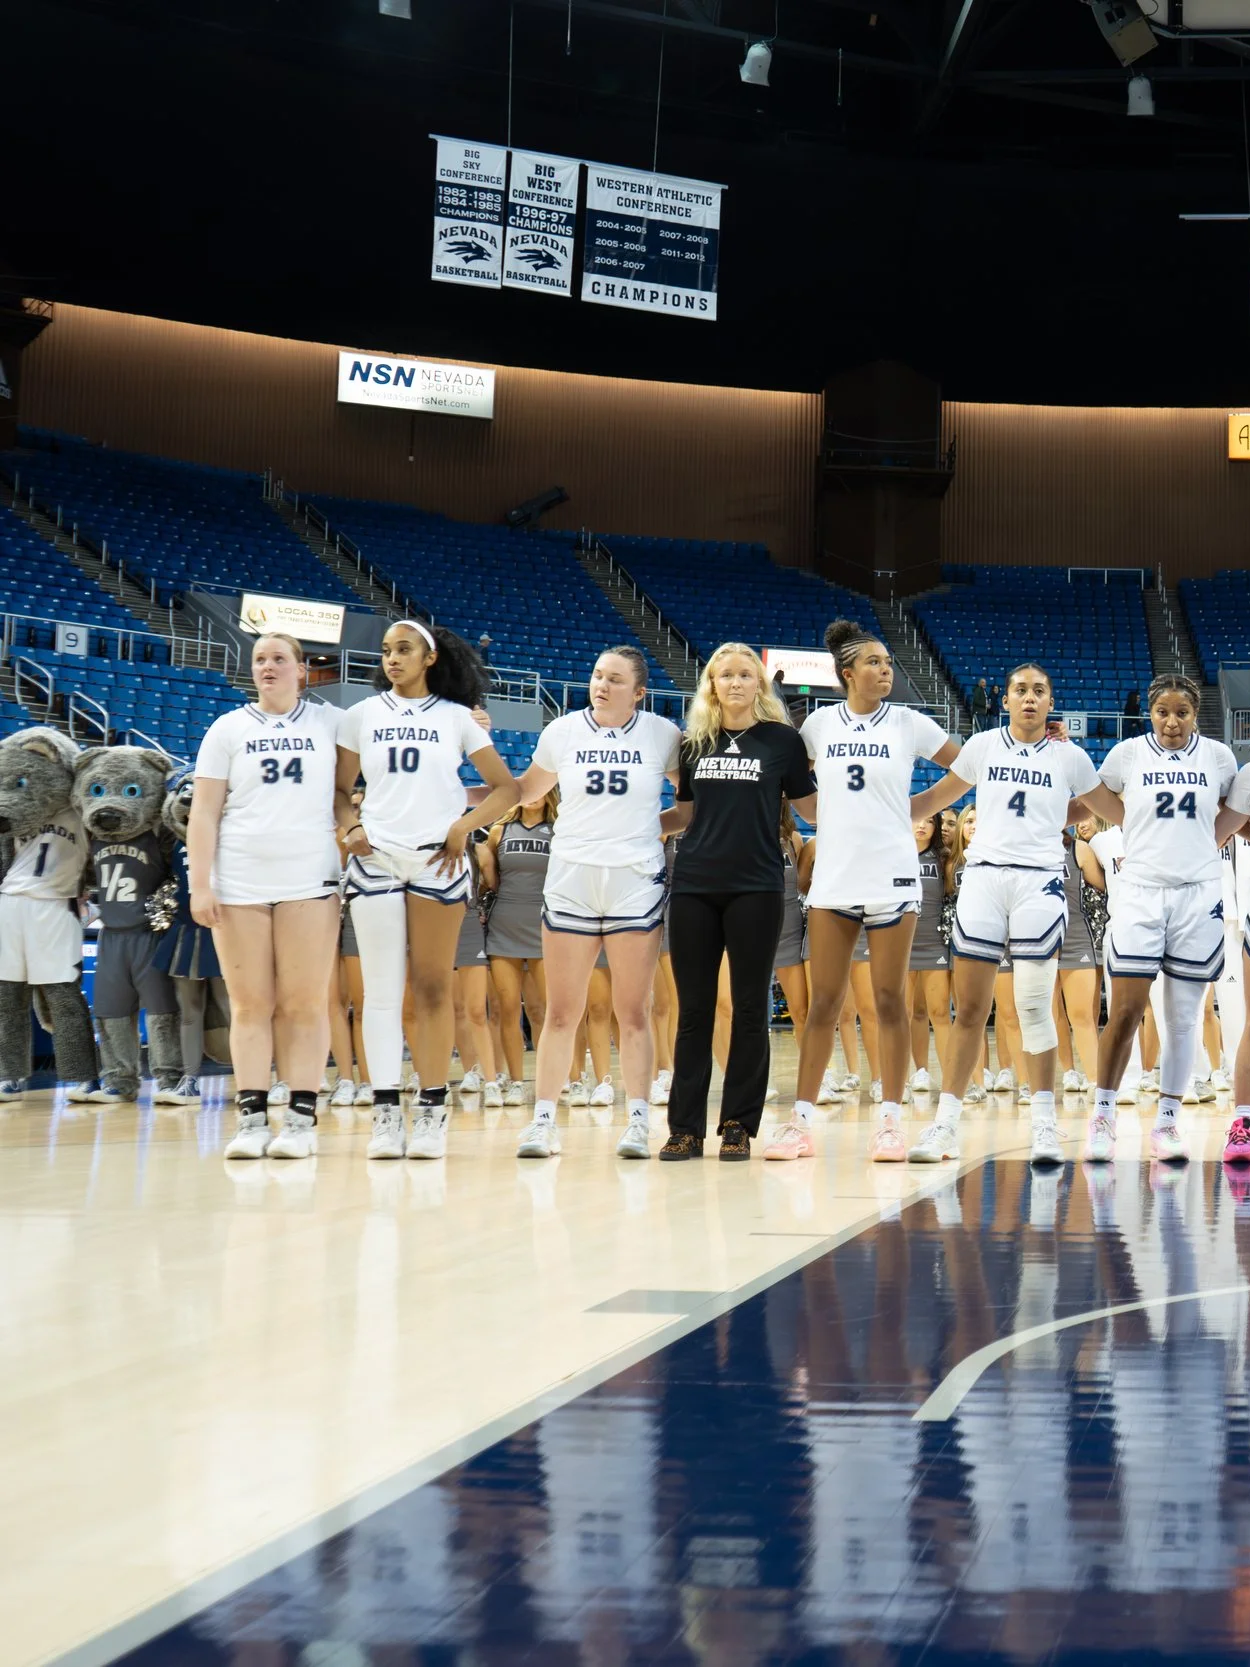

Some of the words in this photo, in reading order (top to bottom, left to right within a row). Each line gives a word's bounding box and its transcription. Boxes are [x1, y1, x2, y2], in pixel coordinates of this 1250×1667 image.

[464, 150, 480, 160] BIG
[463, 161, 481, 170] SKY
[535, 164, 555, 178] BIG
[440, 169, 502, 185] CONFERENCE
[527, 176, 561, 193] WEST
[512, 189, 573, 208] CONFERENCE
[596, 177, 652, 196] WESTERN
[657, 188, 712, 206] ATHLETIC
[440, 208, 499, 222] CHAMPIONS
[516, 206, 567, 223] 1996-97
[617, 197, 692, 218] CONFERENCE
[509, 216, 572, 235] CHAMPIONS
[439, 226, 497, 248] NEVADA
[510, 234, 568, 258] NEVADA
[436, 265, 498, 280] BASKETBALL
[506, 271, 567, 288] BASKETBALL
[592, 281, 708, 311] CHAMPIONS
[349, 361, 415, 387] NSN
[422, 370, 484, 387] NEVADA
[278, 607, 314, 617] LOCAL
[318, 611, 339, 620] 350
[65, 633, 78, 647] 9
[1068, 719, 1081, 730] 13
[373, 728, 439, 743] NEVADA
[246, 738, 315, 754] NEVADA
[826, 744, 890, 759] NEVADA
[388, 747, 420, 773] 10
[576, 750, 642, 764] NEVADA
[697, 757, 760, 772] NEVADA
[261, 758, 303, 784] 34
[694, 770, 759, 781] BASKETBALL
[847, 765, 865, 791] 3
[988, 766, 1052, 788] NEVADA
[1142, 772, 1208, 786] NEVADA
[586, 770, 629, 795] 35
[1008, 790, 1026, 818] 4
[1156, 792, 1197, 819] 24
[33, 843, 49, 877] 1
[94, 845, 149, 864] NEVADA
[101, 863, 137, 901] 1/2
